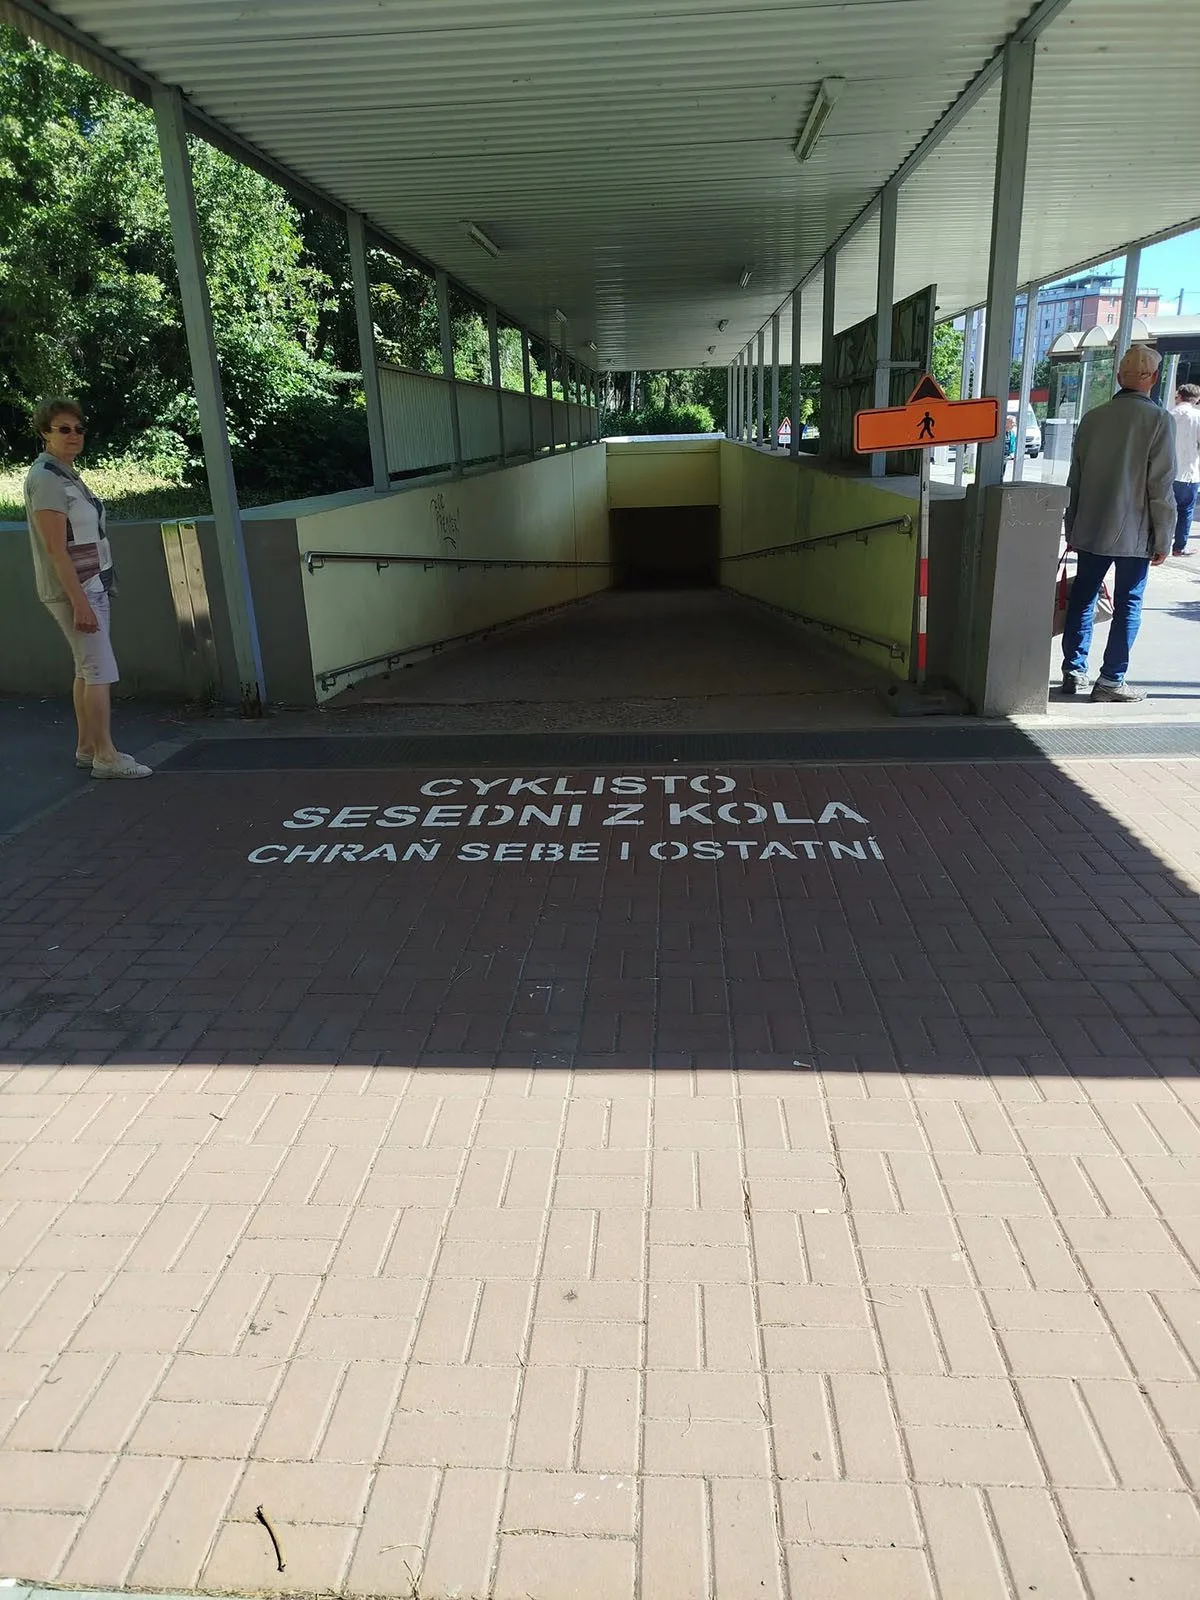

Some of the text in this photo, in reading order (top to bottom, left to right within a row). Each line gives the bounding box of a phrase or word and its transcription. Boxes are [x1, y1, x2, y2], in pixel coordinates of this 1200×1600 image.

[420, 775, 737, 797] CYKLISTO
[282, 801, 870, 829] SESEDNI Z KOLA
[247, 835, 885, 864] CHRAŇ SEBE I OSTATNÍ
